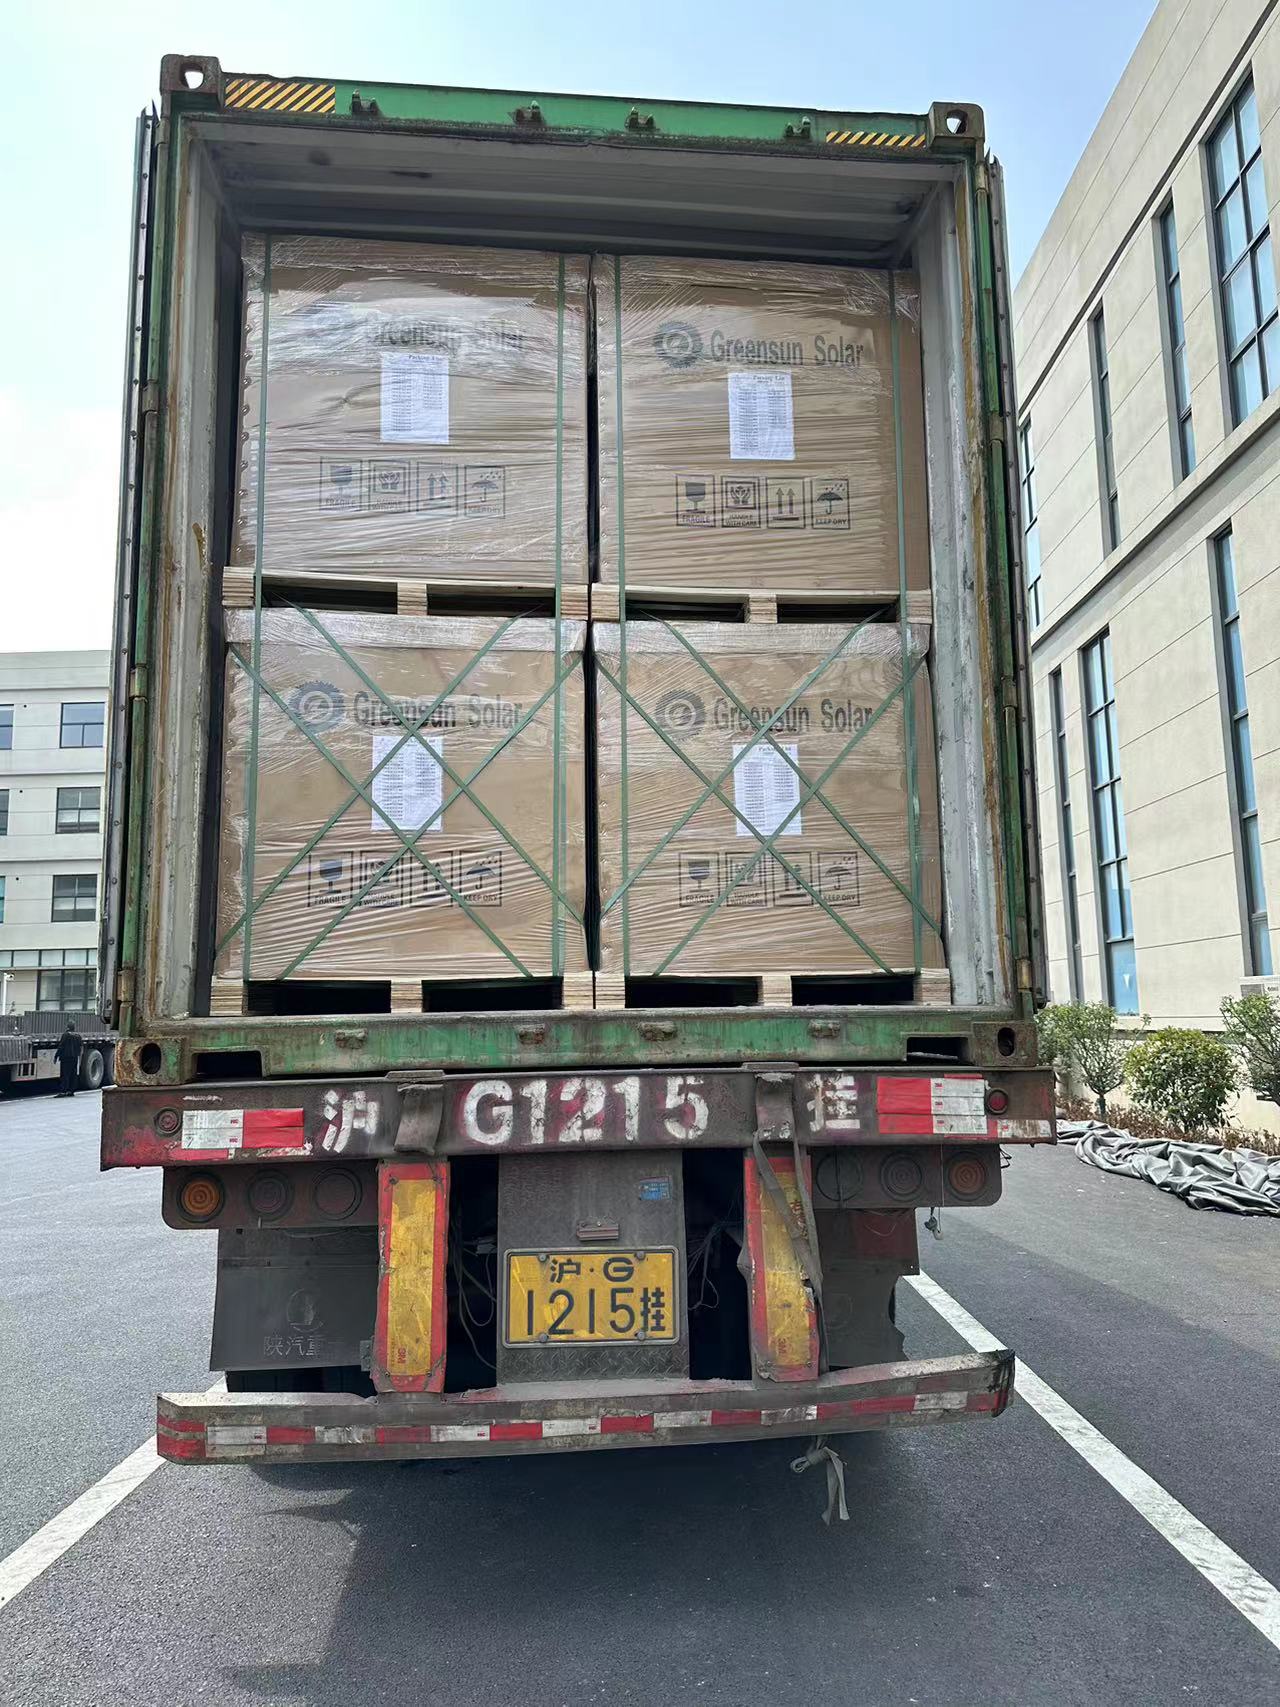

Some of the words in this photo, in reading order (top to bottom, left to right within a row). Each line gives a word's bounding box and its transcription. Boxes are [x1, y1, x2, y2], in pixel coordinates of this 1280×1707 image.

[711, 330, 803, 365] Greensun
[814, 334, 863, 367] Solar
[466, 692, 523, 729] Solar
[821, 698, 872, 733] Solar
[322, 1090, 379, 1153] 沪
[463, 1075, 709, 1146] G1215
[526, 1286, 666, 1336] 1215挂
